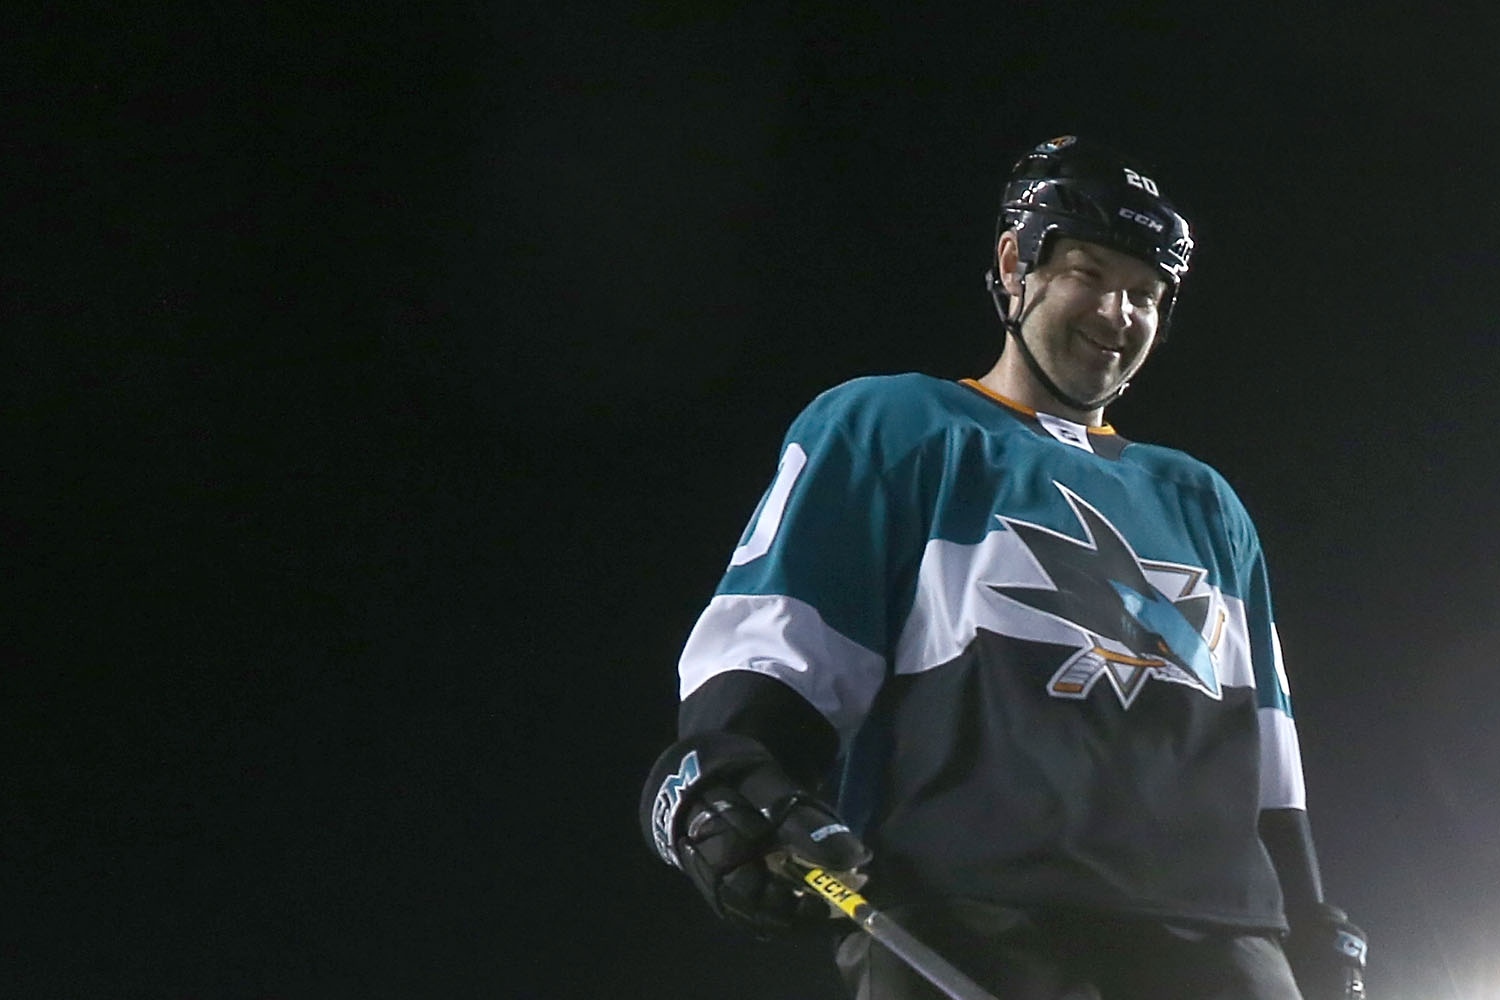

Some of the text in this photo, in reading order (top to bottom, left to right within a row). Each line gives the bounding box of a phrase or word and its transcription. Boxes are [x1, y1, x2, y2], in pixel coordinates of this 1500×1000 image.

[1124, 167, 1159, 197] 20
[1118, 207, 1164, 233] CCM
[813, 873, 852, 902] CCM
